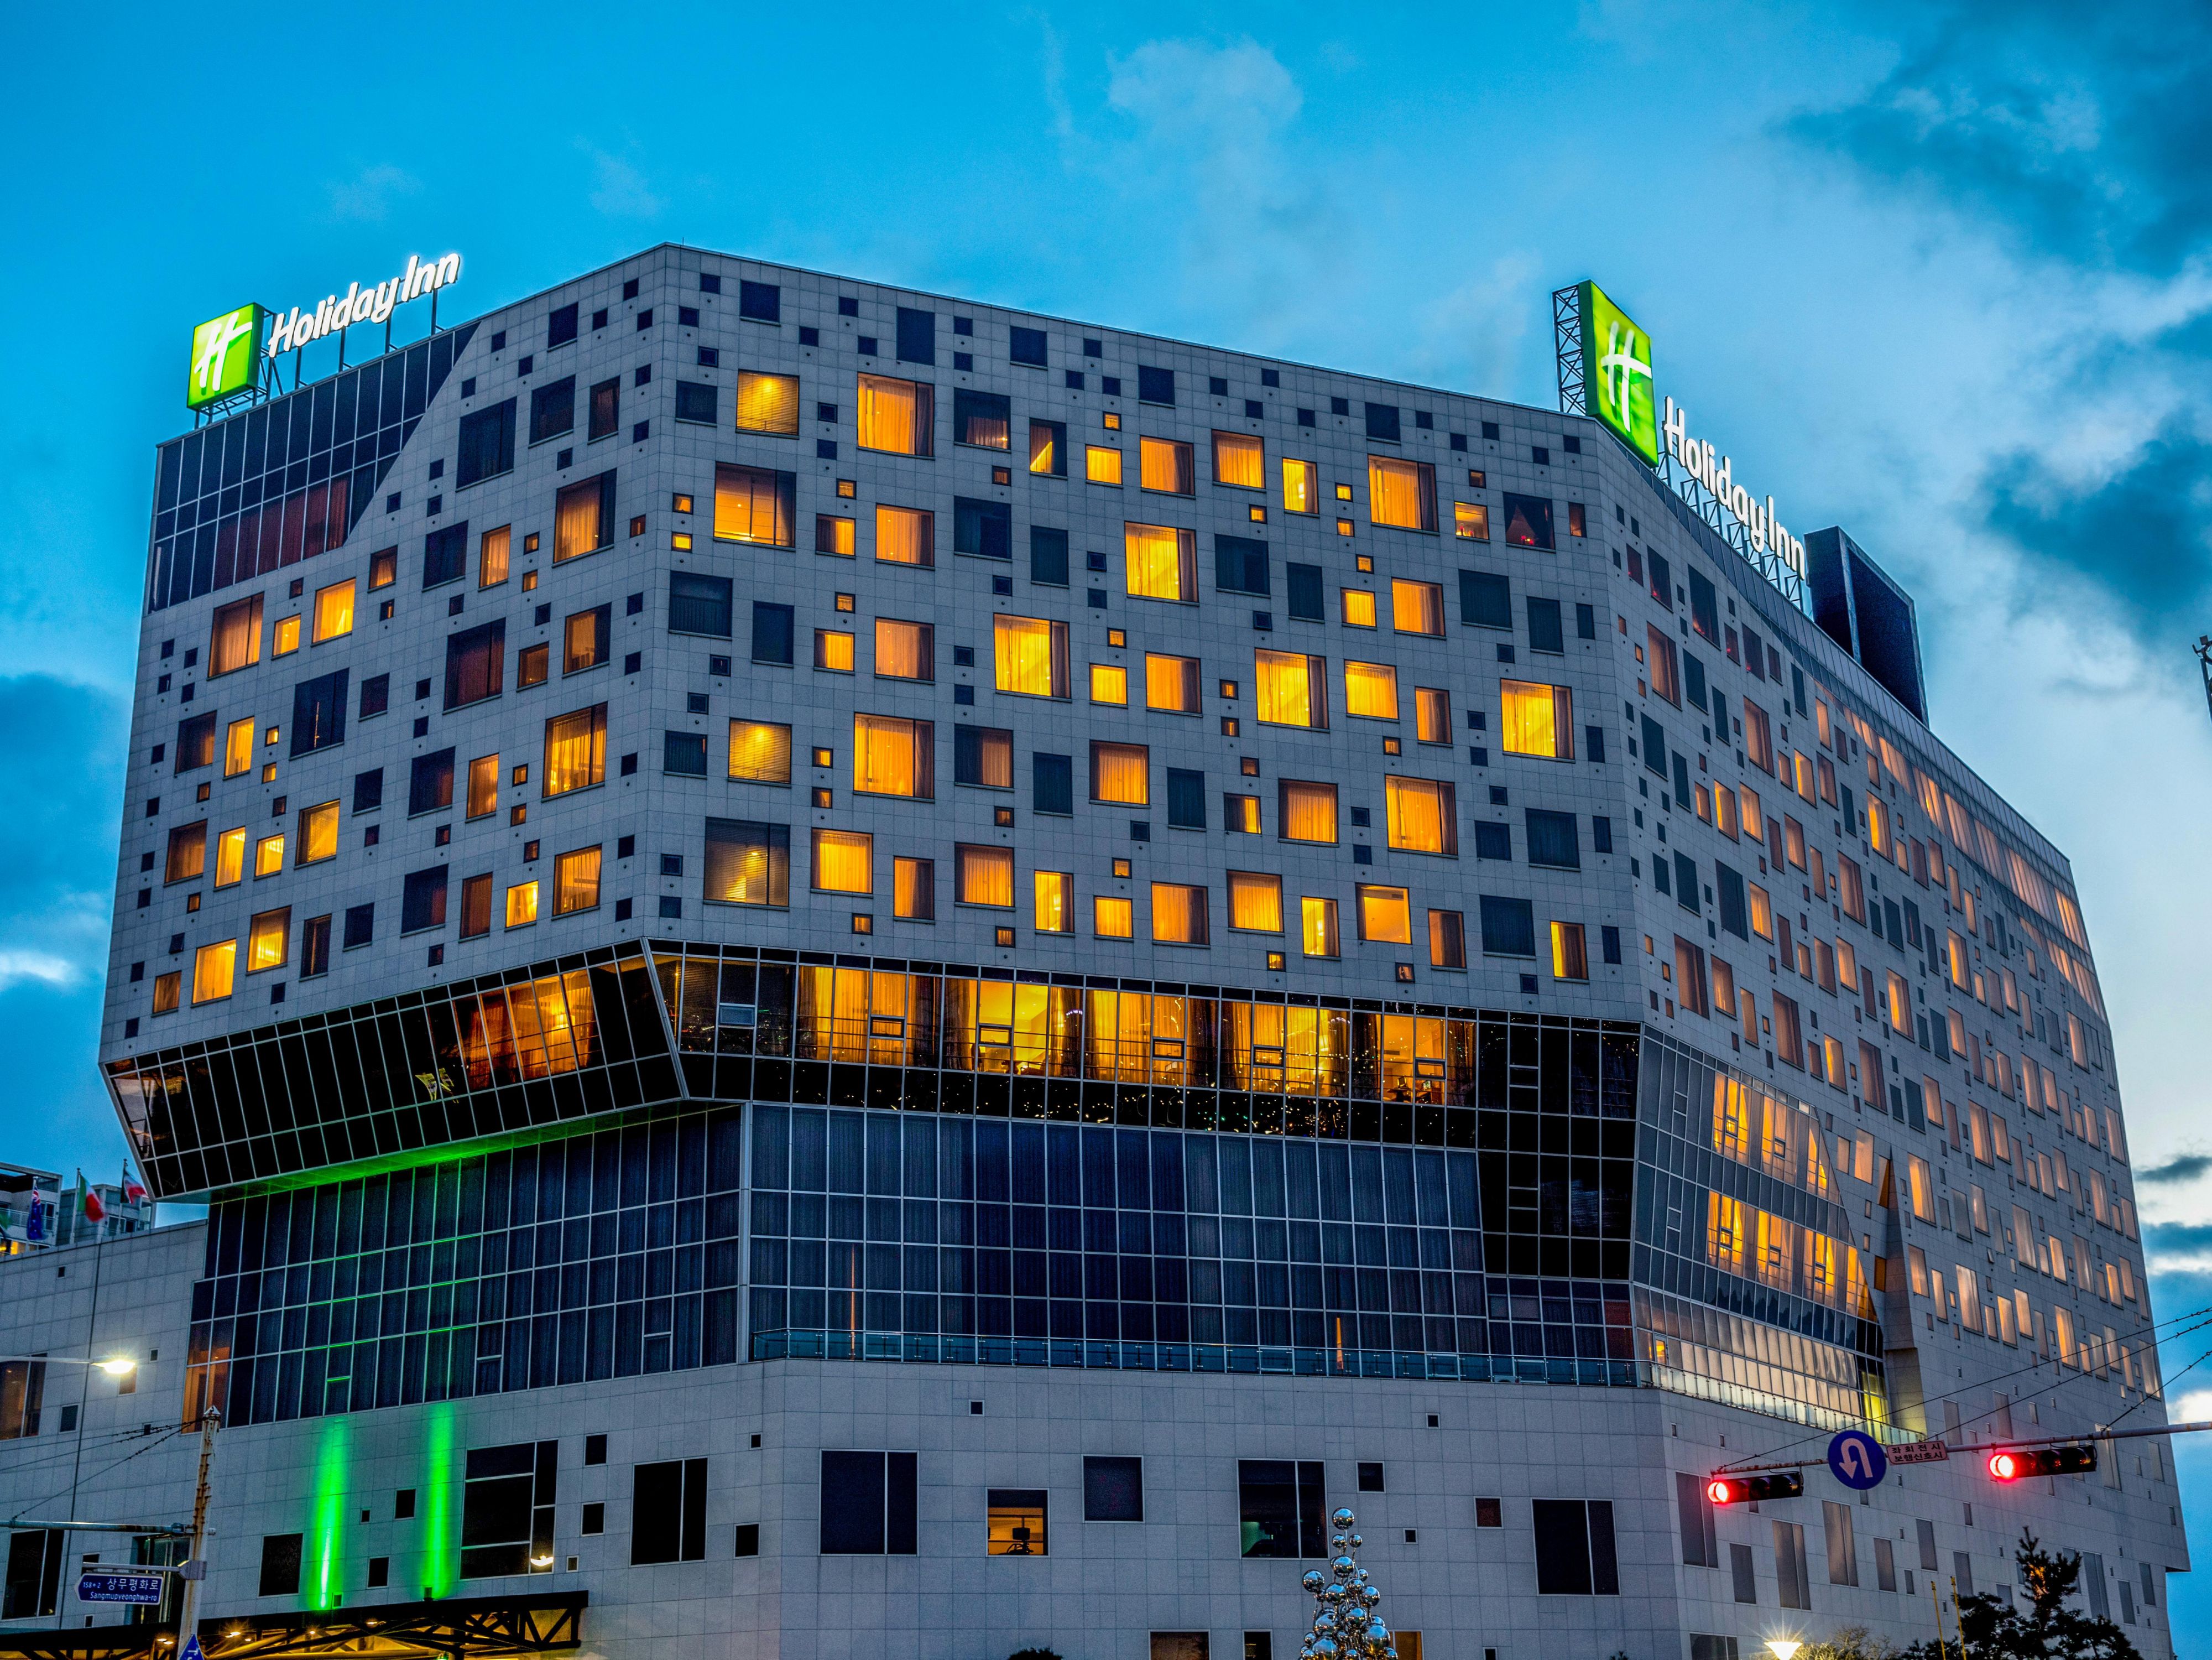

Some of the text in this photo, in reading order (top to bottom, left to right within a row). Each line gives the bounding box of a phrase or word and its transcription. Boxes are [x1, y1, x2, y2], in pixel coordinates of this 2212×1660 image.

[268, 253, 460, 358] Holiday Inn
[1662, 396, 1806, 581] Holiday Inn
[1895, 1451, 1943, 1462] 보행신호시
[107, 1578, 158, 1591] 상무평화로
[90, 1591, 157, 1601] Sangmupyeonghwa-ro
